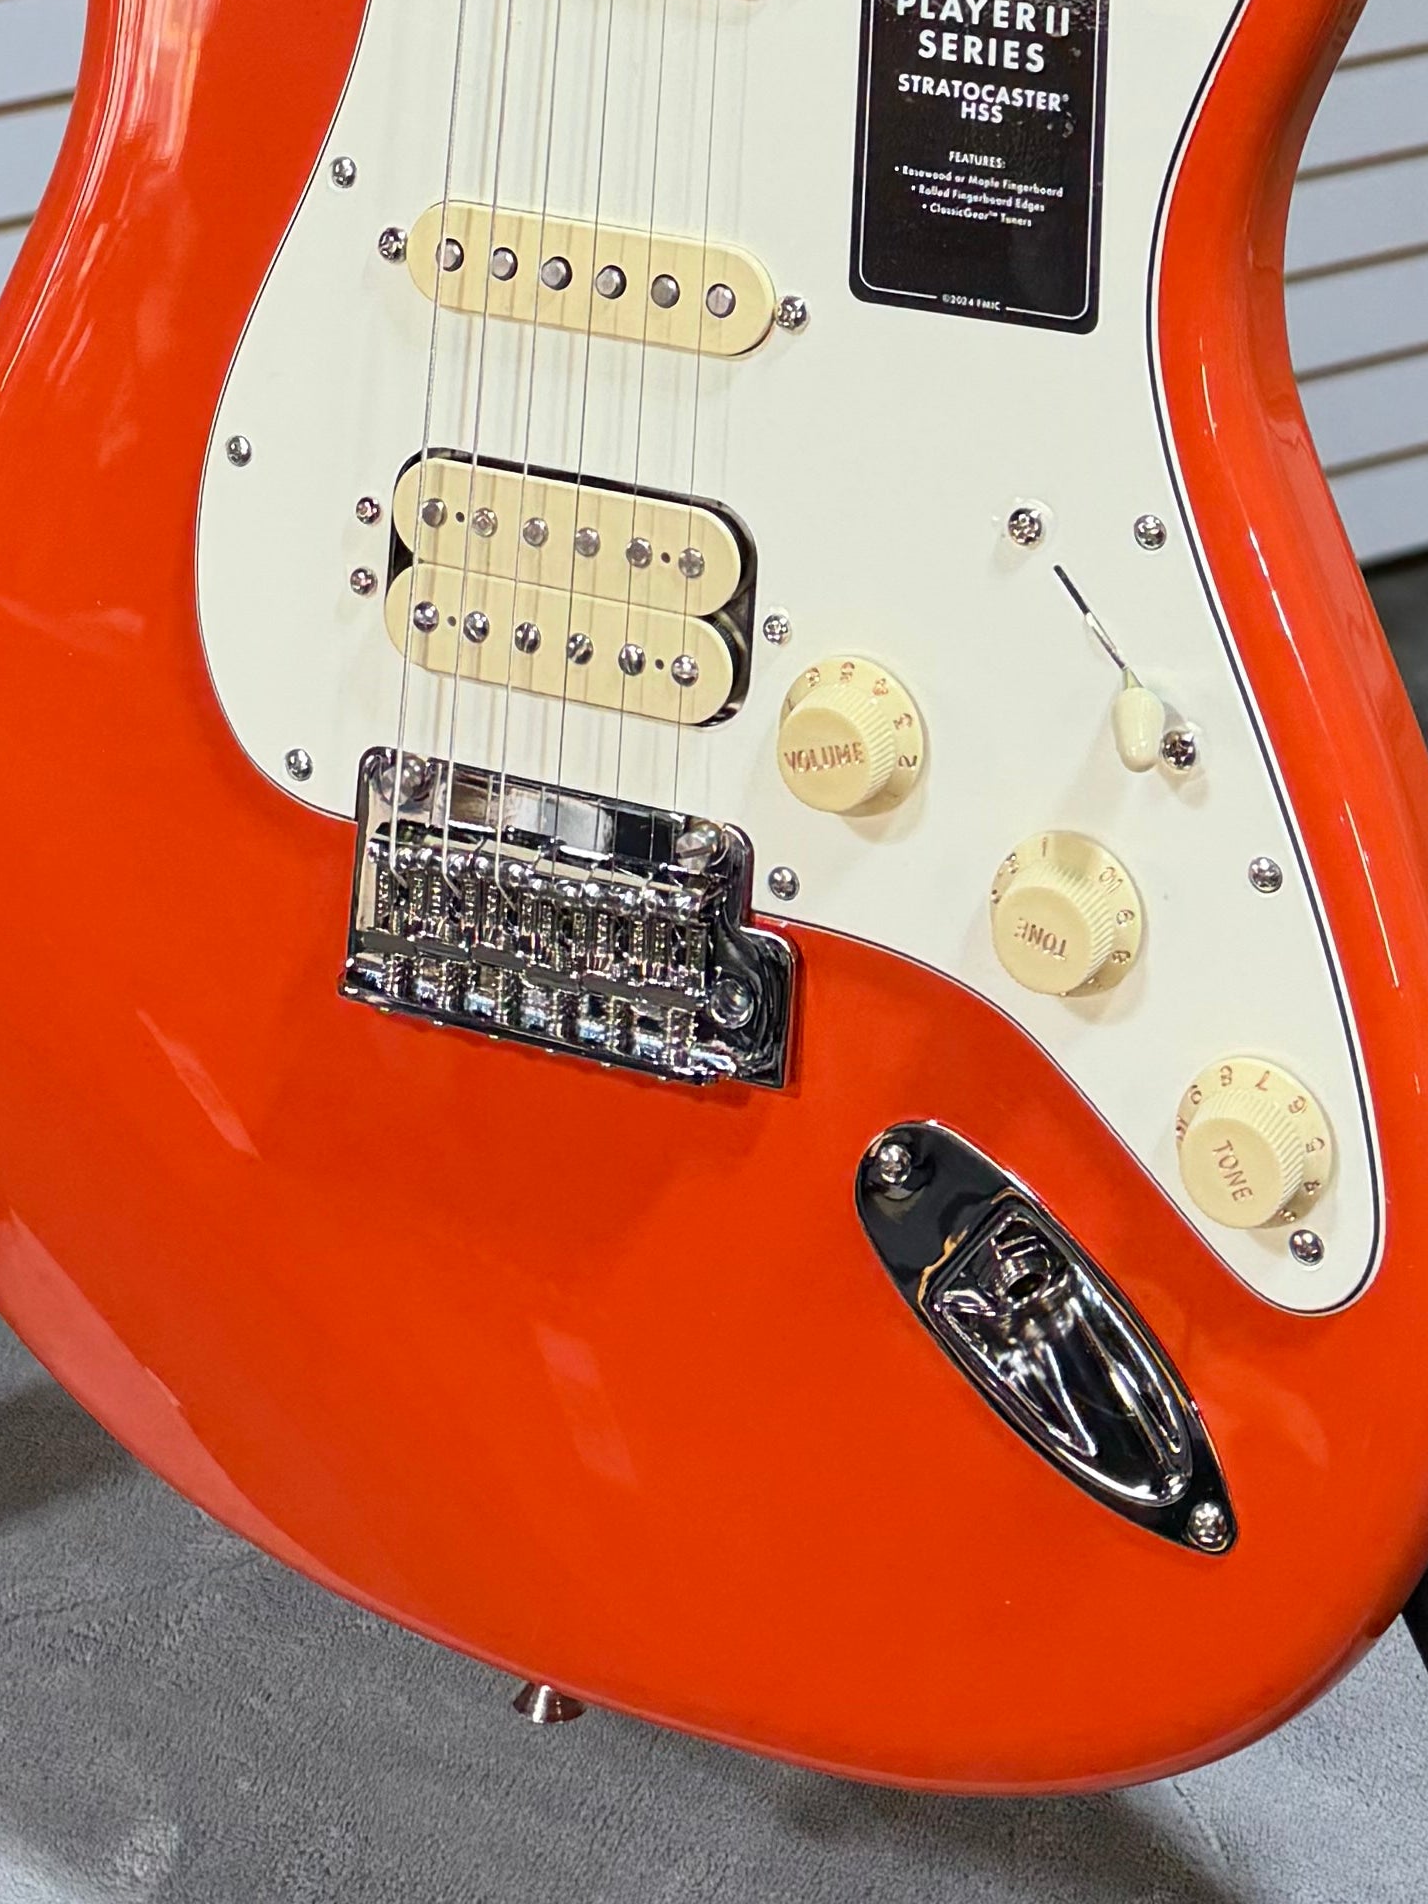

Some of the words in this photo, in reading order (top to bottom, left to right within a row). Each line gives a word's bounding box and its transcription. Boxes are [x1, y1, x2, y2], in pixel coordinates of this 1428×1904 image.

[1045, 5, 1070, 37] II
[917, 29, 1045, 74] SERIES
[960, 100, 1003, 124] HSS
[948, 150, 1007, 170] FEATURES:
[902, 164, 953, 183] Rosewood
[954, 174, 966, 184] or
[967, 175, 1000, 190] Maple
[1002, 178, 1064, 198] Fingerboard
[918, 183, 950, 199] Rolled
[951, 188, 1013, 208] Fingerboard
[1014, 197, 1046, 213] Edges
[1000, 212, 1033, 228] Tuners
[783, 741, 866, 774] VOLUME
[1012, 916, 1067, 960] TONE
[1211, 1139, 1254, 1202] TONE
